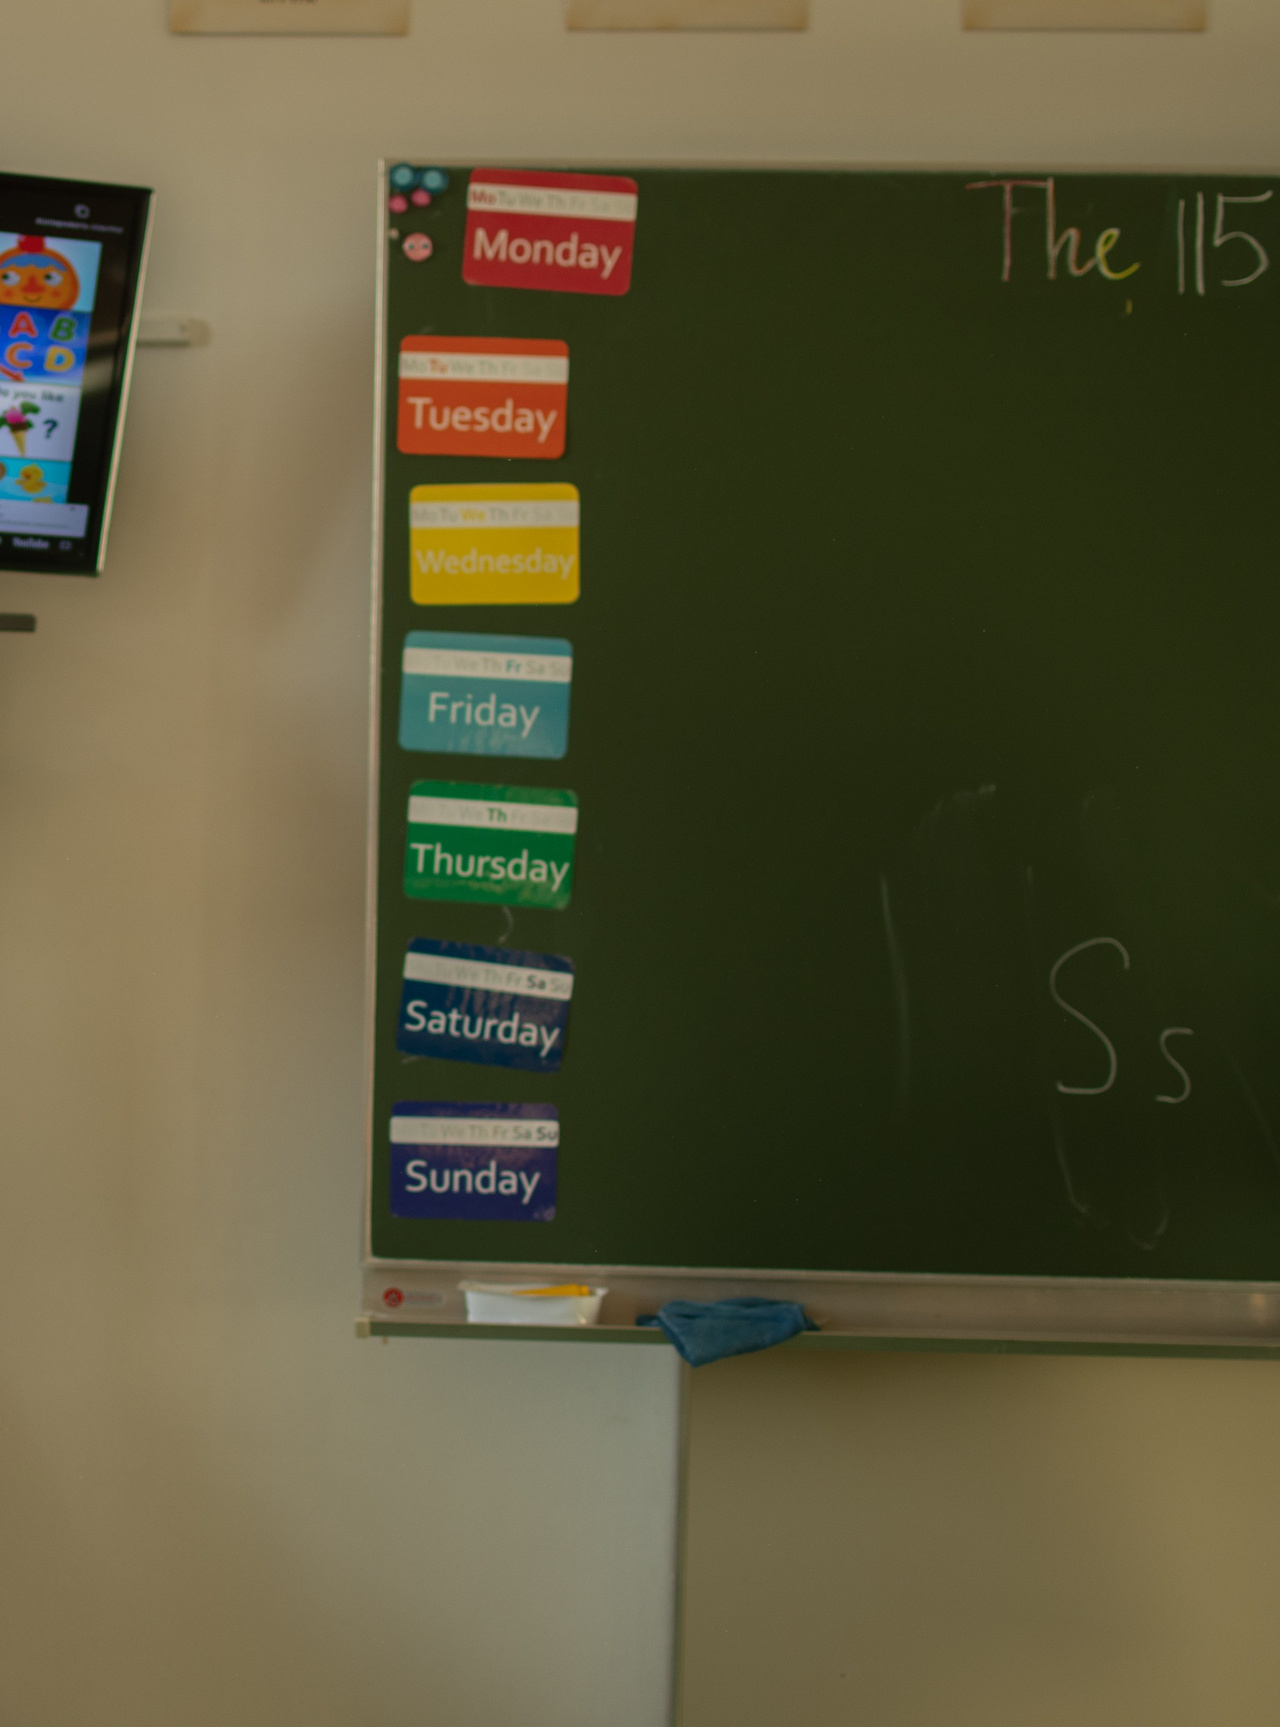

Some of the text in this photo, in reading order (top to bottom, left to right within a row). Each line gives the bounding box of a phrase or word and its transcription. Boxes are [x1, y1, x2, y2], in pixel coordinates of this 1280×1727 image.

[471, 190, 497, 206] Mo
[965, 176, 1140, 281] The
[473, 227, 623, 281] Monday
[8, 311, 77, 342] A B
[5, 342, 76, 372] C D
[429, 358, 449, 374] Tu
[13, 388, 37, 402] you
[41, 390, 64, 402] like
[42, 418, 59, 440] ?
[406, 396, 558, 444] Tuesday
[13, 537, 50, 550] YouTube
[415, 547, 576, 580] Wednesday
[505, 659, 522, 674] Fr
[428, 692, 540, 739] Friday
[486, 807, 508, 823] Th
[410, 842, 570, 893] Thursday
[526, 974, 547, 991] Sa
[404, 1000, 561, 1058] Saturday
[1049, 935, 1130, 1095] S
[493, 1125, 508, 1140] Fr
[512, 1125, 532, 1141] Sa
[536, 1125, 558, 1142] Su
[405, 1159, 541, 1205] Sunday
